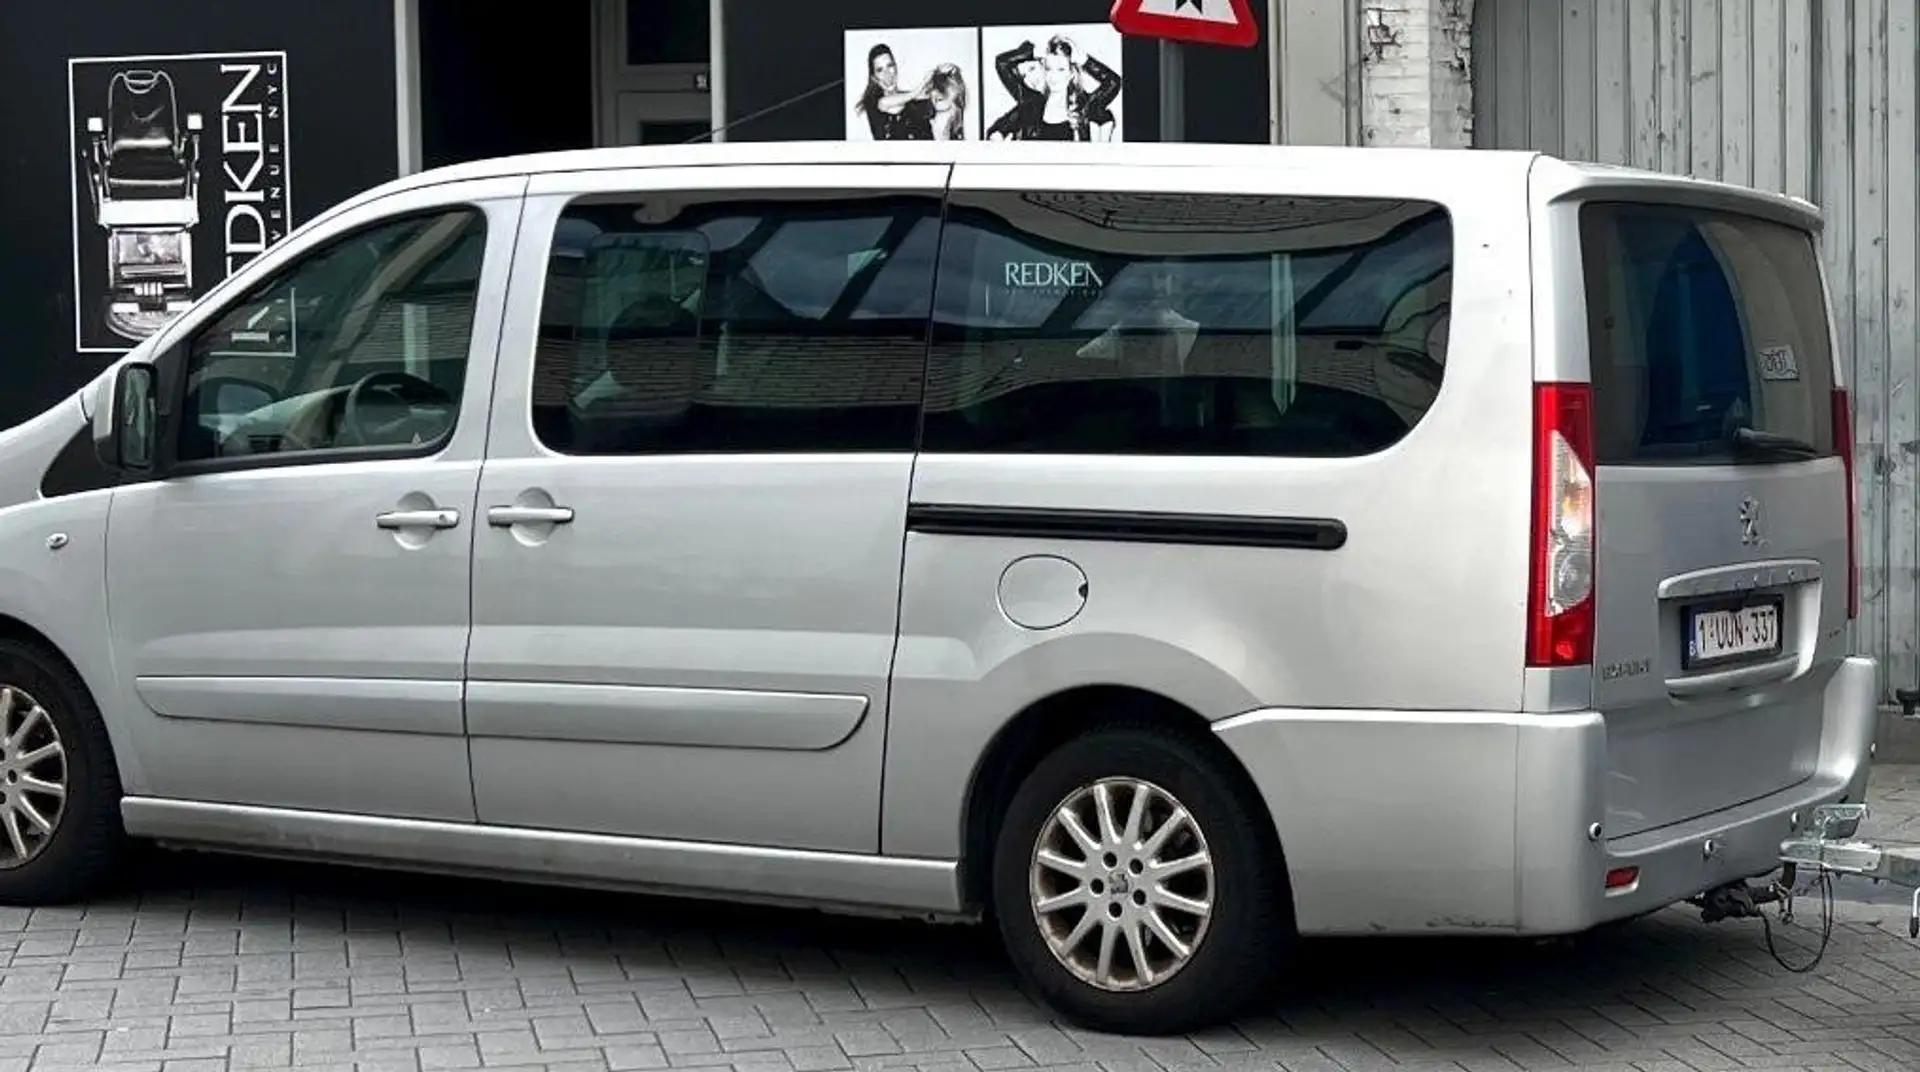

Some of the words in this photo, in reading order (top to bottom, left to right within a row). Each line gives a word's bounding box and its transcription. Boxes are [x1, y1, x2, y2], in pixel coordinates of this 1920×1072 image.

[266, 62, 280, 119] NYC
[268, 143, 282, 242] VENUE
[1004, 261, 1103, 288] REDKEN
